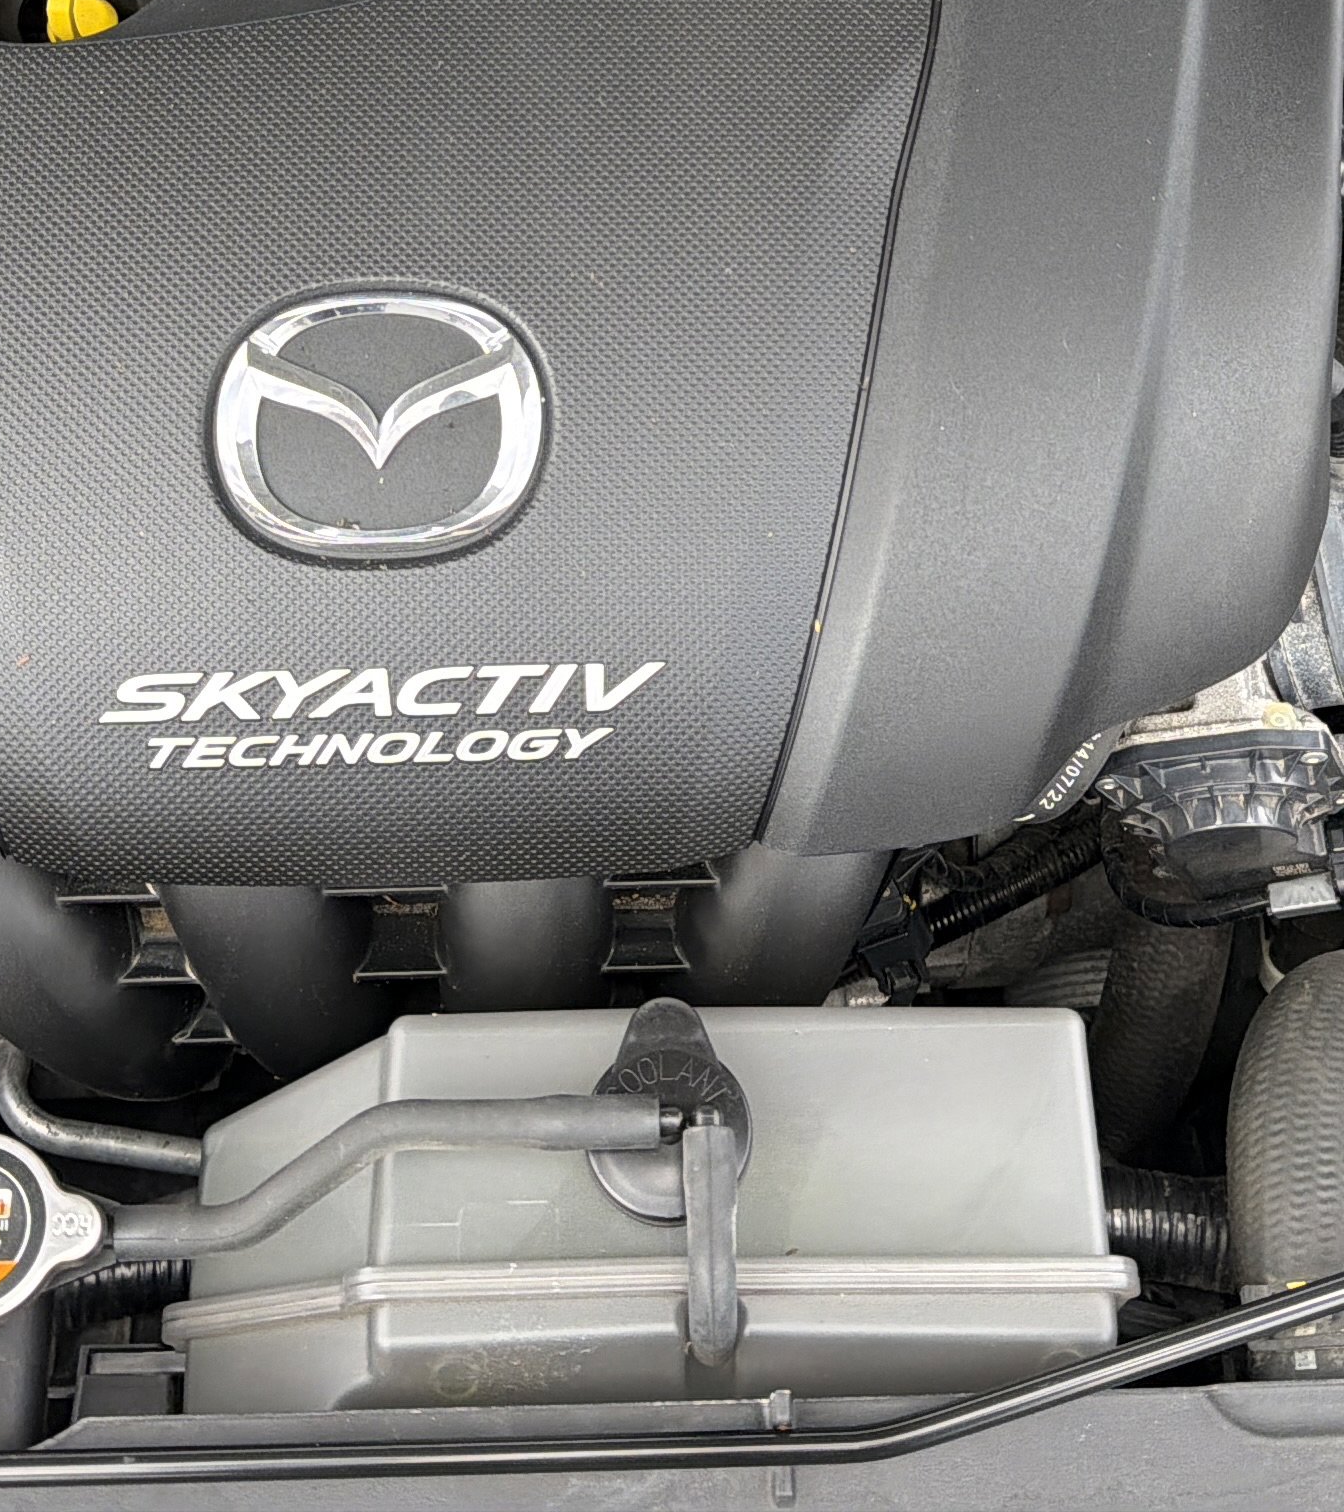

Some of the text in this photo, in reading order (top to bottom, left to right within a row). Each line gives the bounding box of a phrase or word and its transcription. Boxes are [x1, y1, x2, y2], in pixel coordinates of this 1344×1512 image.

[98, 660, 666, 725] SKYACTIV
[146, 727, 614, 769] TECHNOLOGY
[606, 1054, 733, 1102] OOLANT
